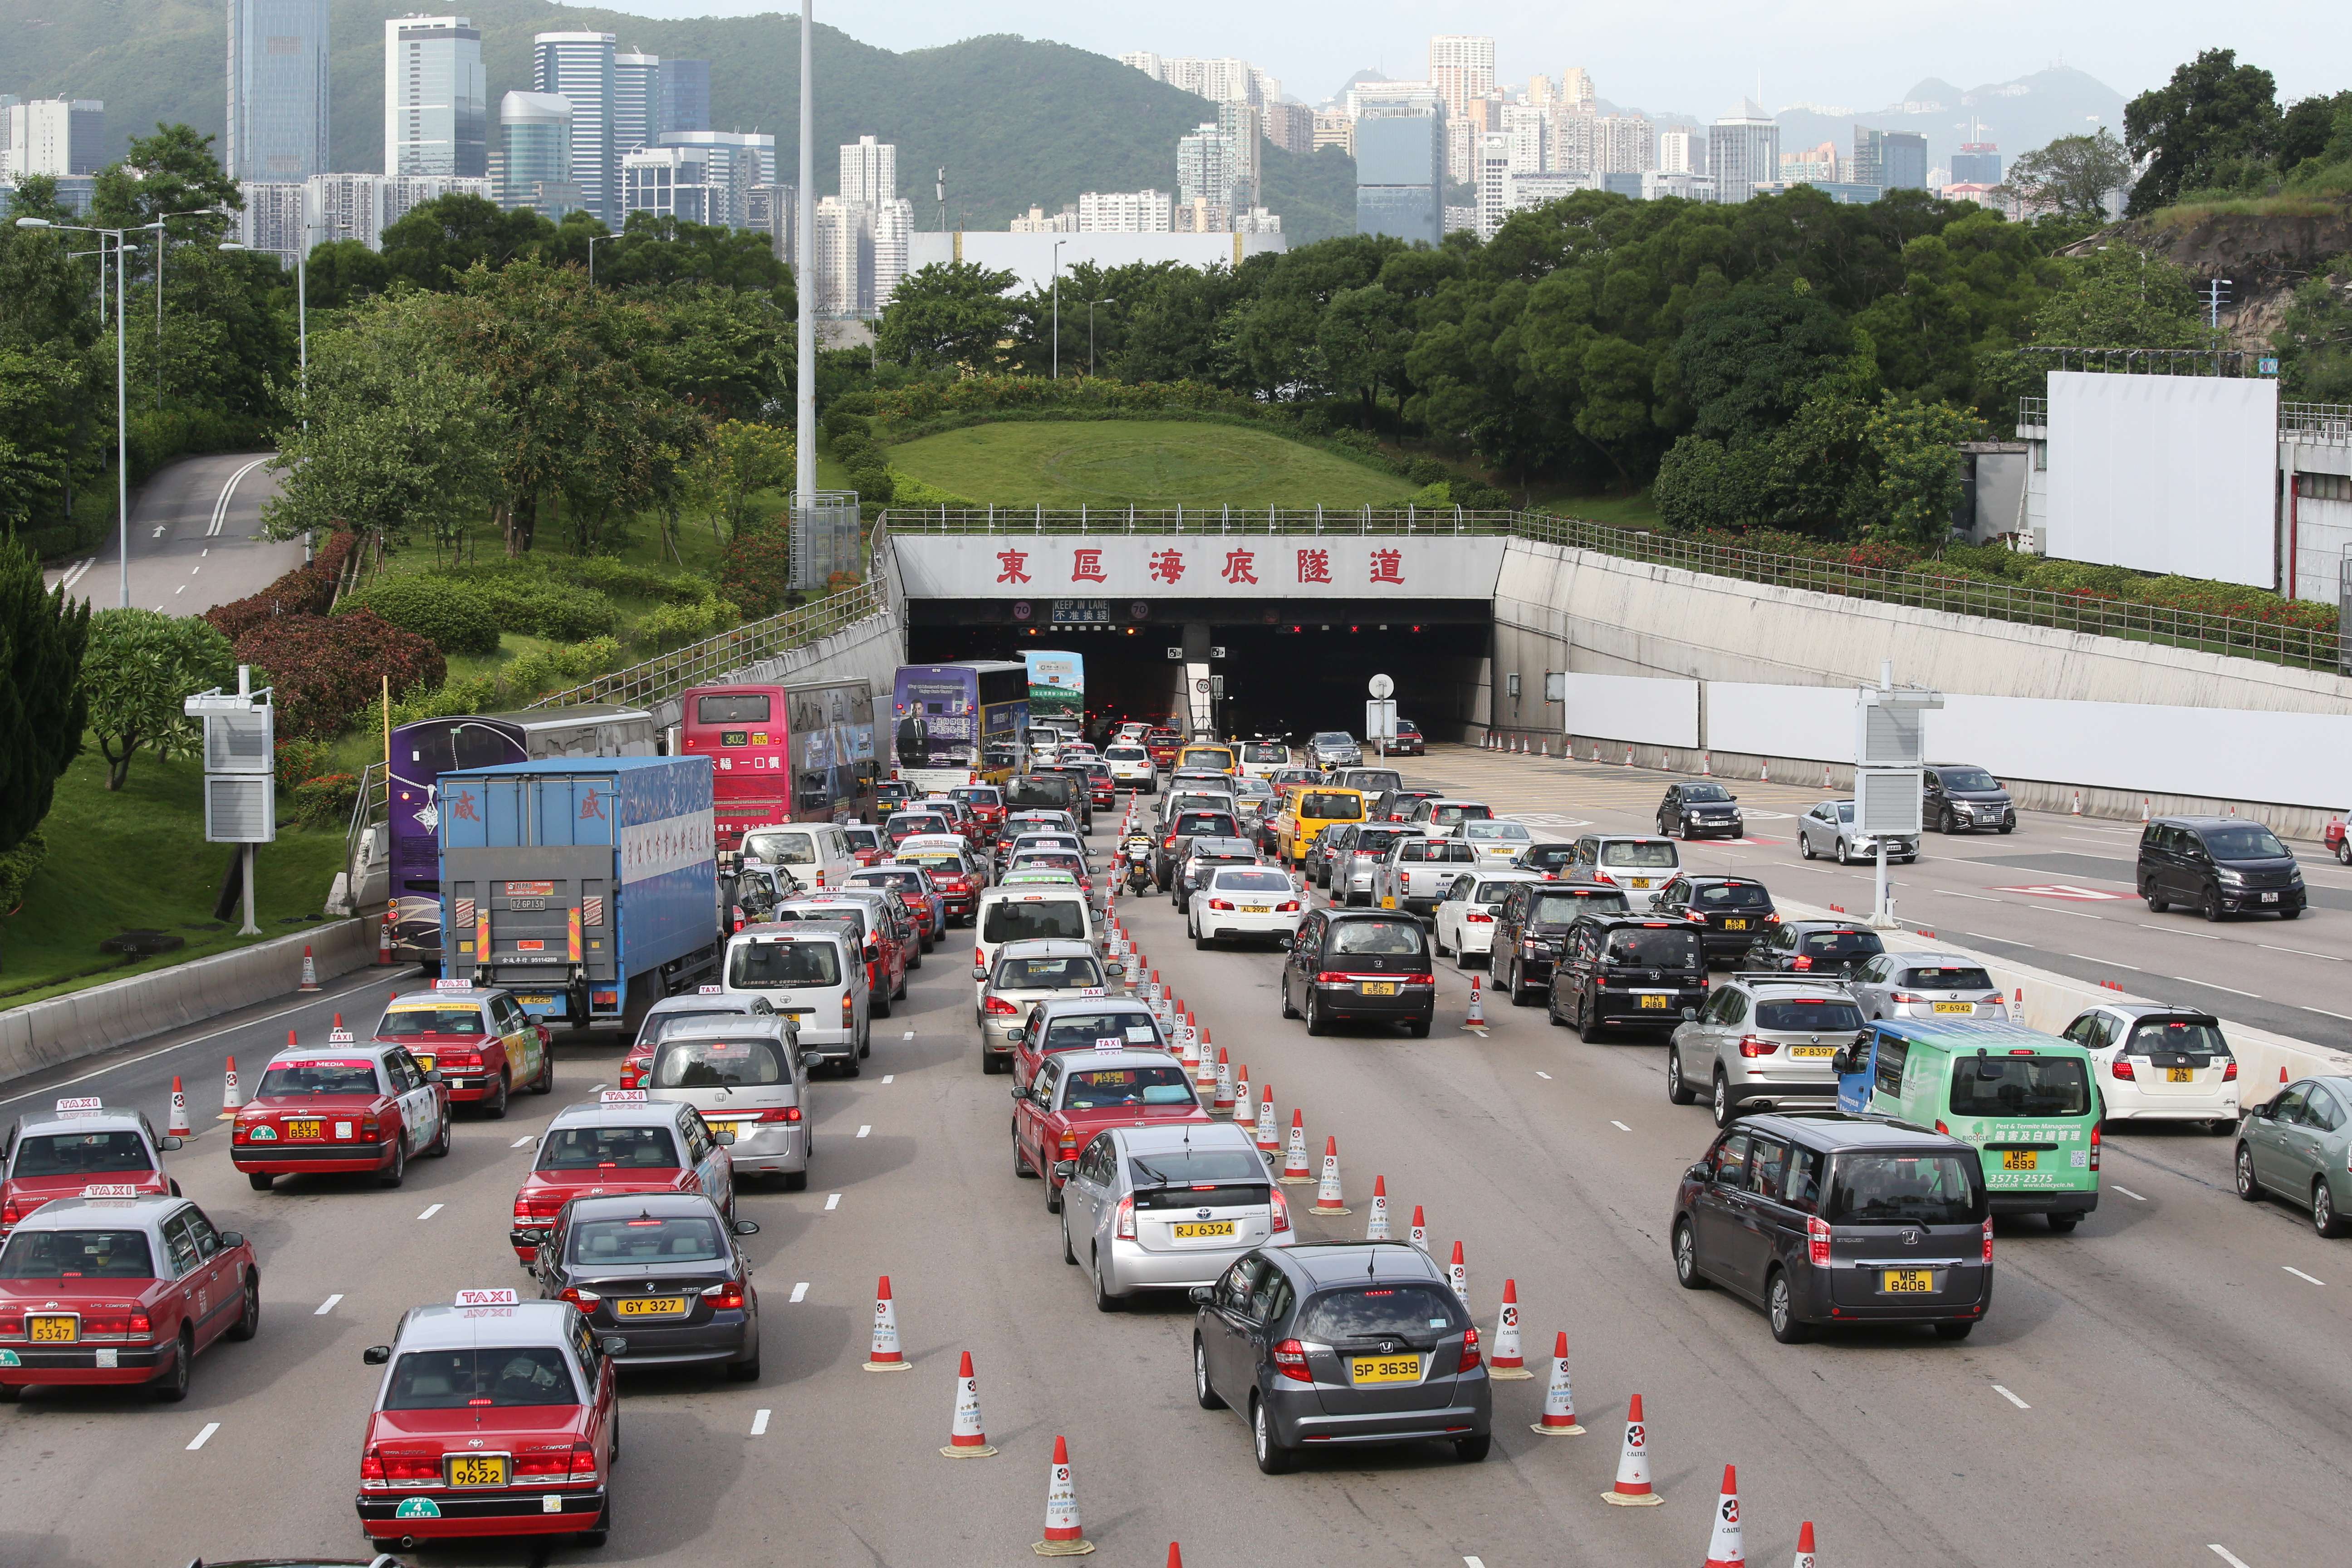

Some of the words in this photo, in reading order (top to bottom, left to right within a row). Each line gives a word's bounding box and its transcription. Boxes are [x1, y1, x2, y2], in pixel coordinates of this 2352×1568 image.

[996, 548, 1405, 585] 東區海底隧道
[1055, 600, 1073, 610] KEEP
[1078, 600, 1085, 609] IN
[1089, 600, 1107, 609] LANE
[1133, 605, 1147, 614] 70
[1016, 606, 1029, 615] 70
[725, 734, 745, 744] 302
[454, 790, 480, 822] 威
[579, 788, 605, 821] 盛
[458, 910, 472, 920] ZEPRO
[585, 907, 600, 917] ZEPRO
[1809, 1048, 1835, 1056] 8397
[606, 1091, 645, 1100] TAXI
[61, 1098, 98, 1108] TAXI
[298, 1121, 312, 1129] KU
[717, 1122, 729, 1130] TV
[290, 1129, 318, 1137] 8533
[1962, 1132, 1989, 1142] BIOCYCLE
[1994, 1131, 2081, 1142] 蟲害及白蟻管理
[2012, 1152, 2028, 1160] MF
[2005, 1160, 2035, 1169] 4693
[1989, 1174, 2053, 1183] 3575-2575
[90, 1186, 132, 1196] TAXI
[1176, 1226, 1193, 1237] RJ
[1199, 1223, 1233, 1235] 6324
[1899, 1271, 1917, 1281] MB
[1891, 1280, 1926, 1292] 8408
[462, 1291, 512, 1303] TAXI
[625, 1301, 643, 1312] GY
[650, 1300, 676, 1311] 327
[45, 1317, 62, 1328] PL
[36, 1329, 70, 1340] 5347
[1354, 1363, 1375, 1376] SP
[1378, 1361, 1419, 1375] 3639
[466, 1458, 488, 1471] KE
[456, 1471, 500, 1484] 9622
[412, 1503, 422, 1511] 4
